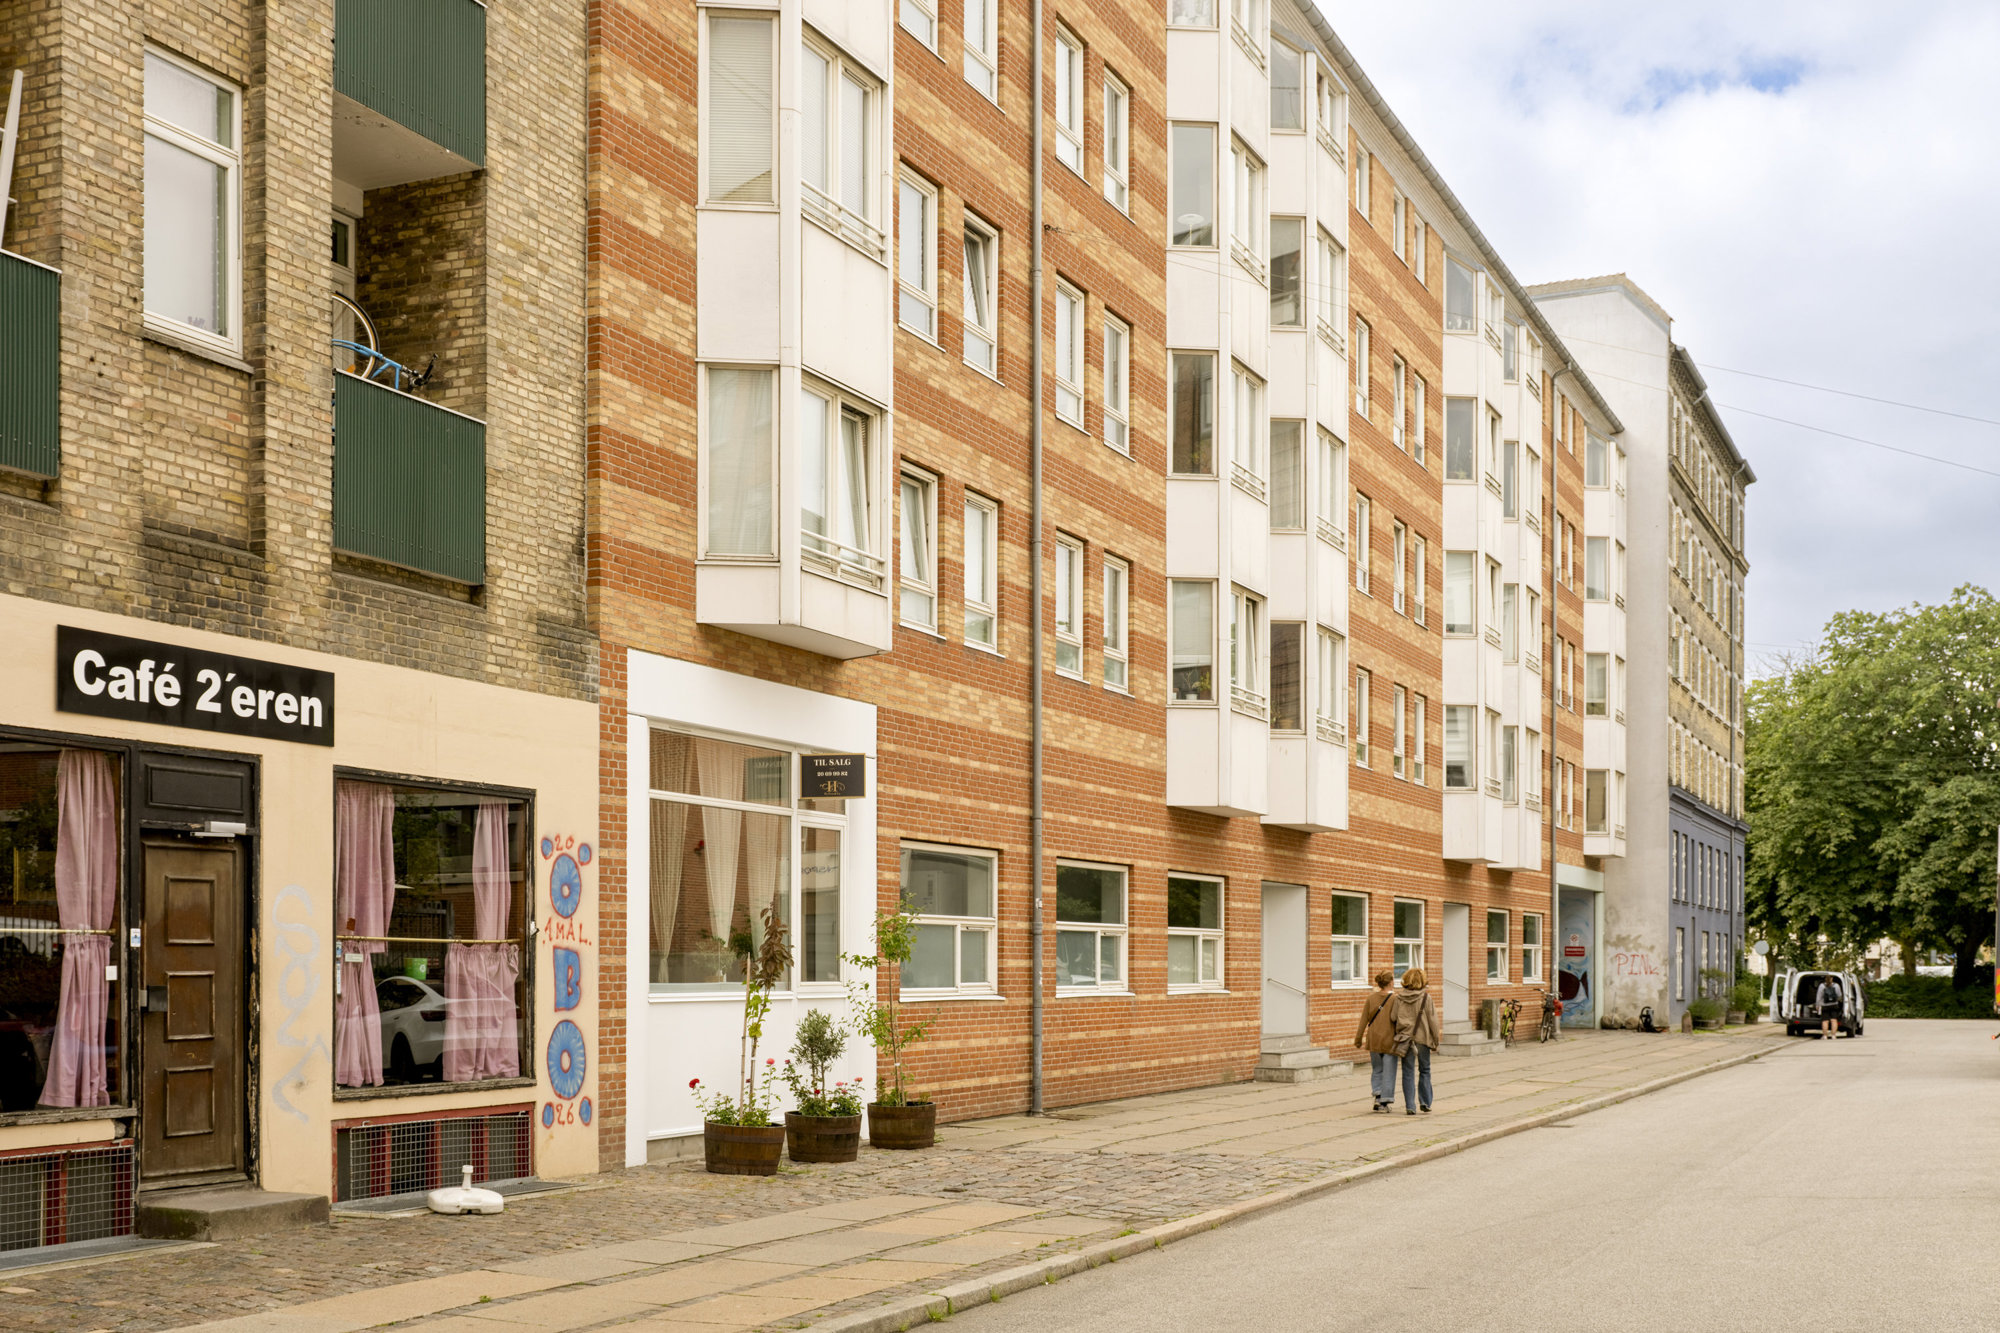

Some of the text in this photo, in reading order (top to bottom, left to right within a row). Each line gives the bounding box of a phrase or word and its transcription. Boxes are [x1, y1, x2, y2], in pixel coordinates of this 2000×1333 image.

[73, 649, 181, 707] Café
[814, 758, 851, 767] TIL SALG
[554, 834, 575, 851] 20
